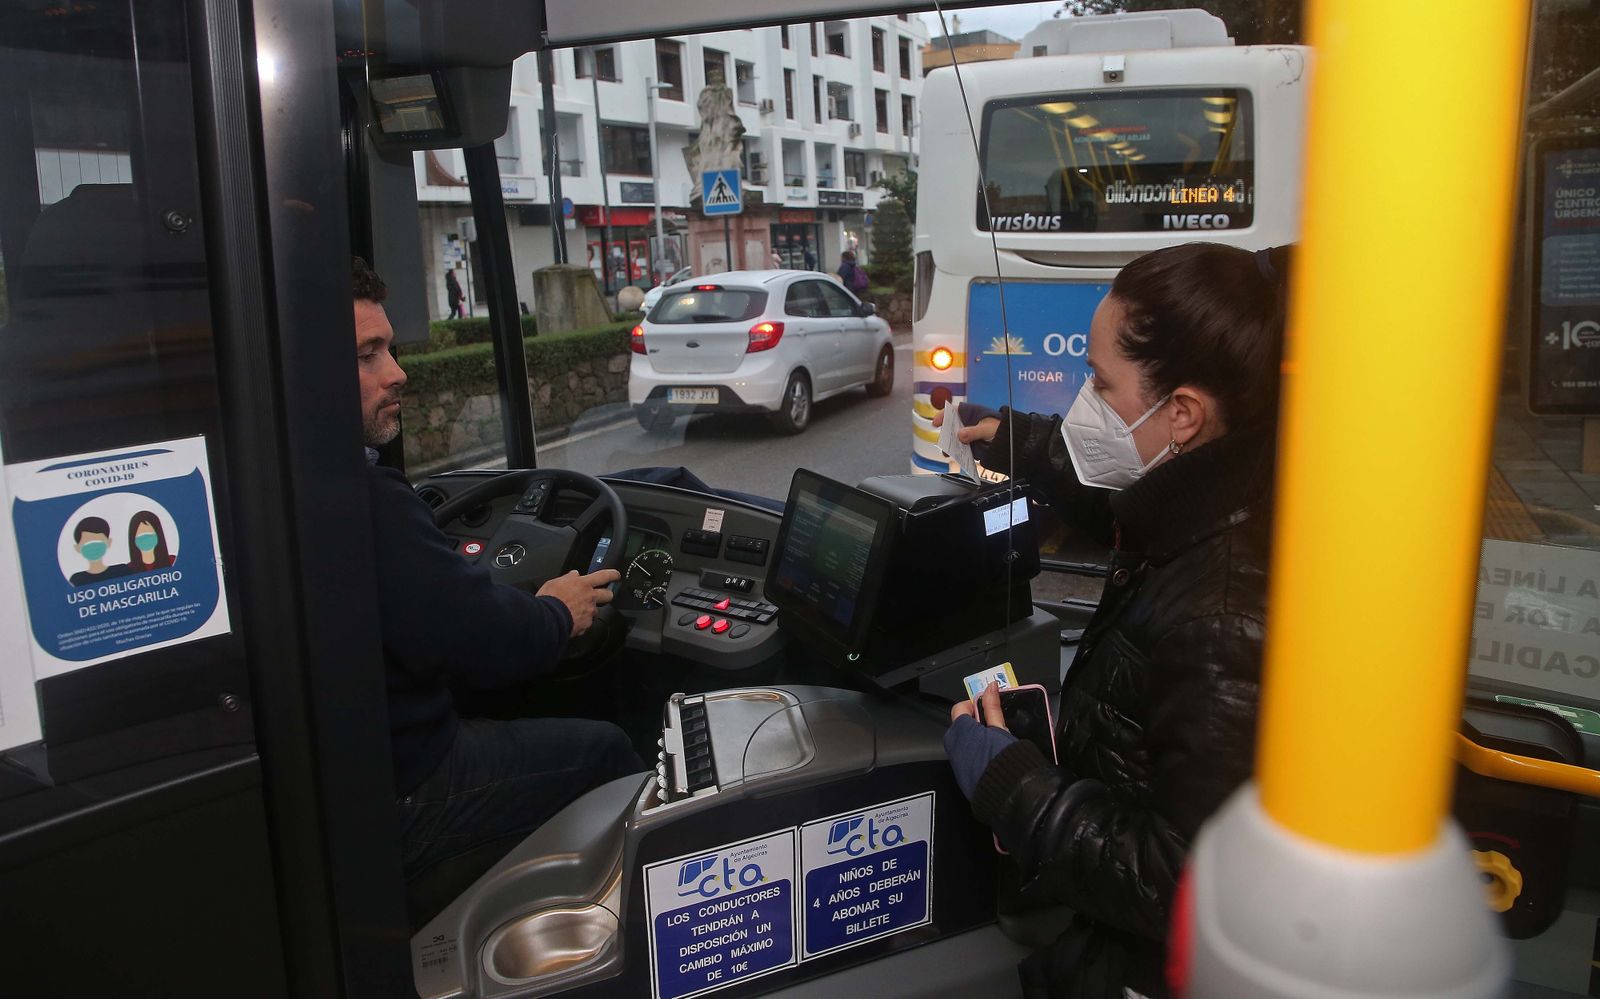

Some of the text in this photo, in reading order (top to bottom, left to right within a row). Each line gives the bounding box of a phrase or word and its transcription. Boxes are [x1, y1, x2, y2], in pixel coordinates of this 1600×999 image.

[1171, 187, 1218, 204] LINEA
[1222, 187, 1235, 203] 4
[1555, 185, 1596, 198] ÚNICO
[1163, 214, 1230, 230] IVECO
[1043, 333, 1089, 357] OC
[1018, 371, 1063, 382] HOGAR
[674, 389, 696, 400] 1932
[67, 460, 149, 480] CORONAVIRUS
[85, 473, 135, 487] COVID-19
[67, 570, 182, 605] USO OBLIGATORIO
[78, 587, 179, 618] DE MASCARILLA
[874, 806, 909, 819] Ayuntamiento
[846, 818, 907, 857] cta
[730, 844, 768, 858] Ayuntamiento
[742, 850, 768, 861] Algeciras
[699, 857, 768, 898] cta
[839, 858, 897, 884] NIÑOS DE
[813, 869, 921, 909] 4 AÑOS DEBERÁN
[667, 886, 781, 927] LOS CONDUCTORES
[832, 892, 903, 922] ABONAR SU
[691, 910, 760, 937] TENDRÁN A
[846, 913, 890, 935] BILLETE
[679, 921, 771, 958] DISPOSICIÓN UN
[679, 937, 773, 975] CAMBIO MÁXIMO
[707, 961, 748, 982] DE 10€
